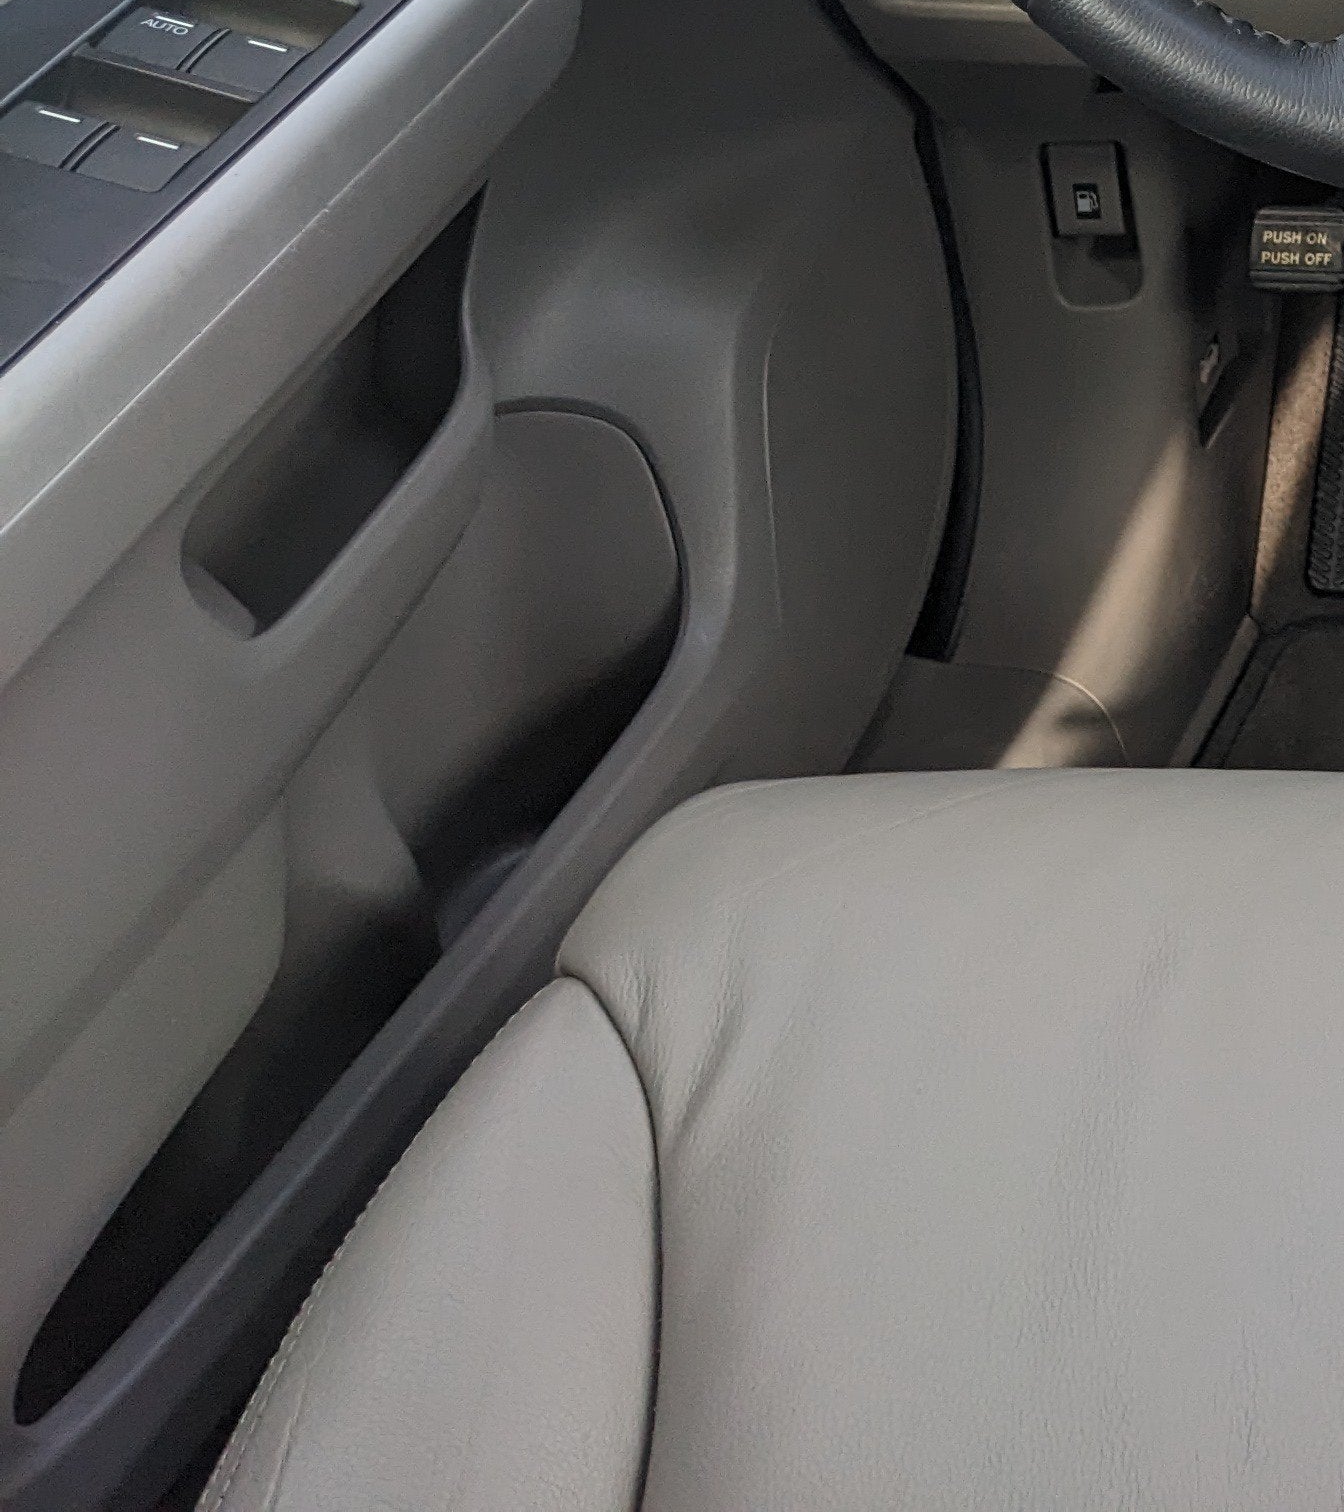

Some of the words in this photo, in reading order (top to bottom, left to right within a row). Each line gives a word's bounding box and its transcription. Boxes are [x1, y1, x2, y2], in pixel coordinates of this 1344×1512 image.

[140, 18, 189, 35] AUTO
[1262, 230, 1302, 244] PUSH
[1306, 232, 1328, 245] ON
[1260, 250, 1300, 265] PUSH
[1304, 252, 1333, 266] OFF
